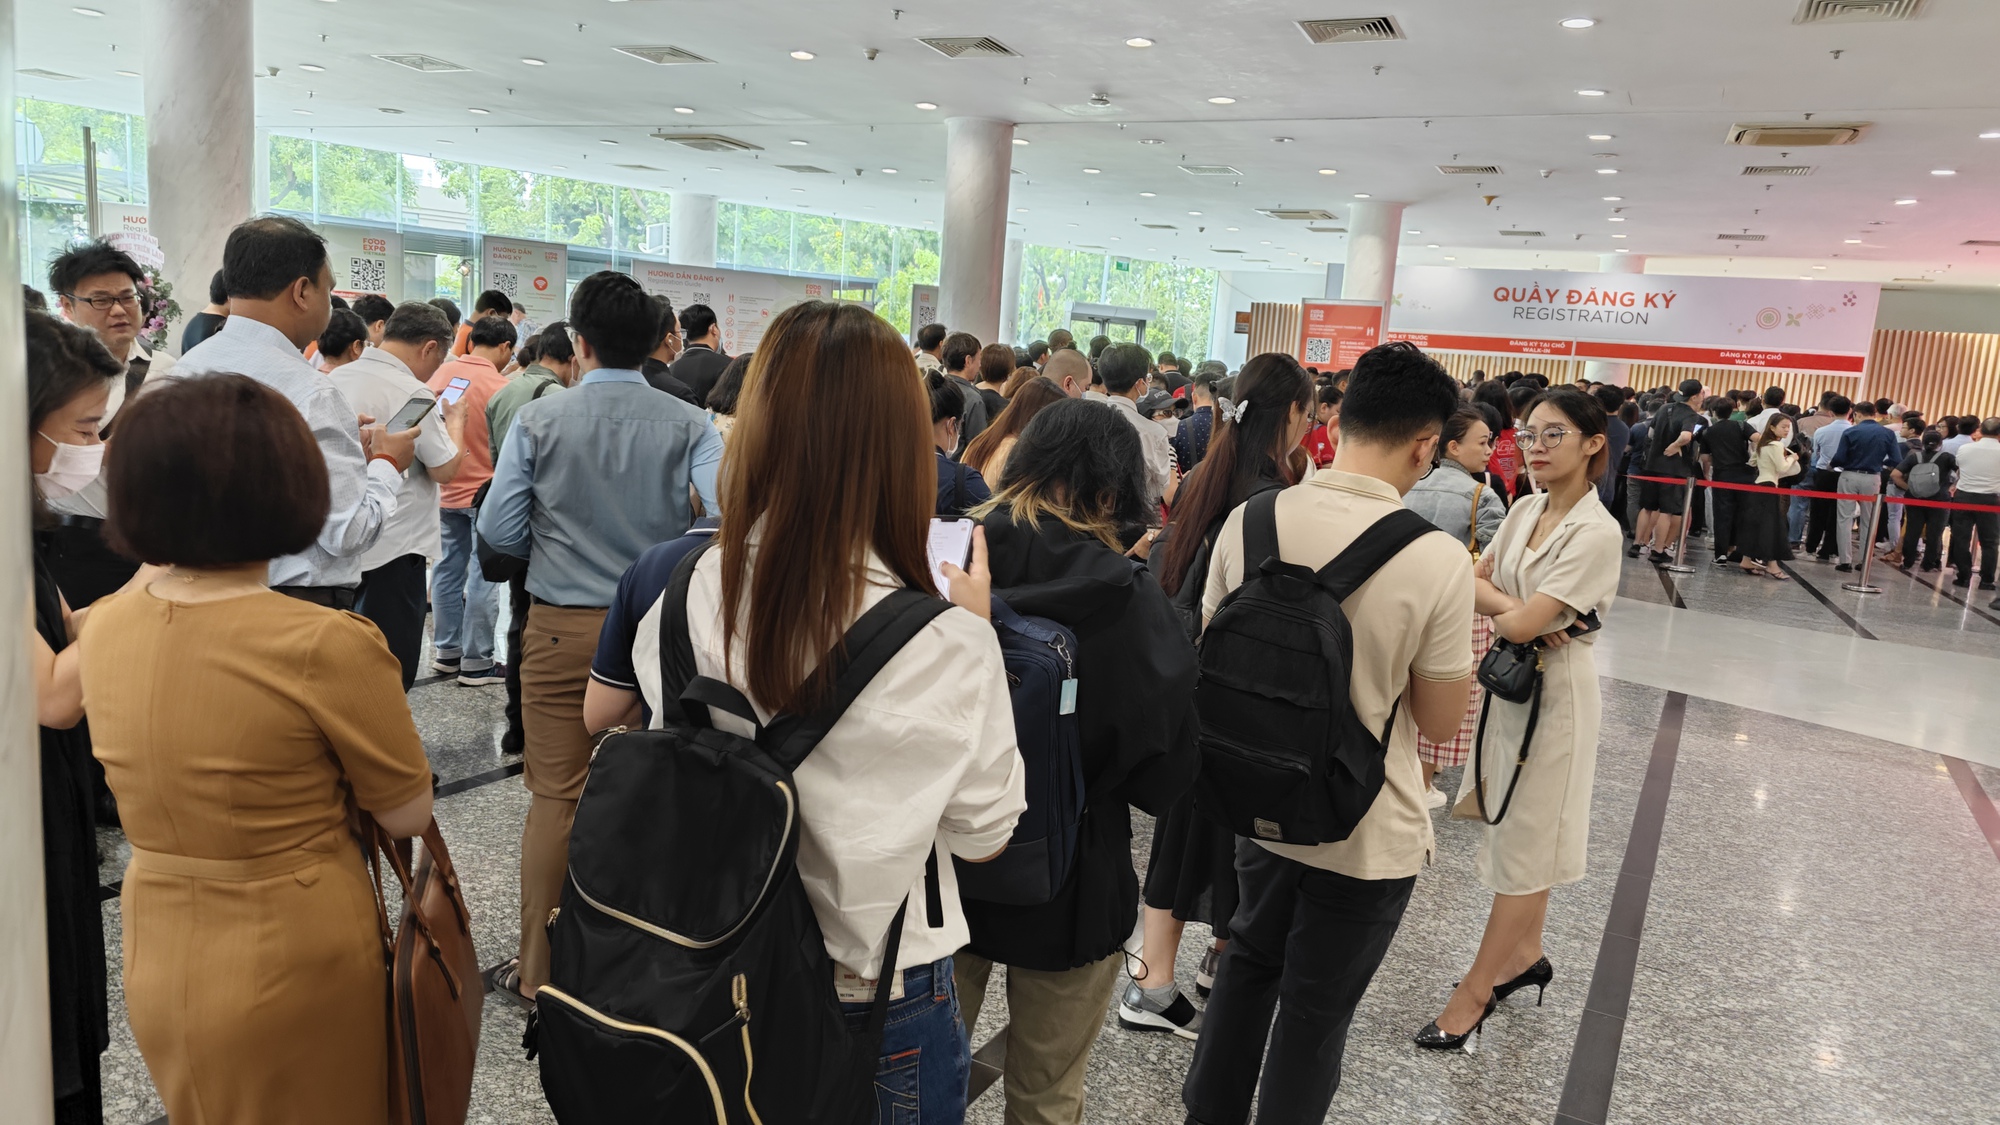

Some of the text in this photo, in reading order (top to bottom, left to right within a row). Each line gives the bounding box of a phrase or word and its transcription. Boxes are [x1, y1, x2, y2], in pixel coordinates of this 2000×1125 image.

[363, 238, 386, 246] FOOD
[1493, 281, 1677, 309] QUẦY ĐĂNG KÝ
[1513, 306, 1650, 325] REGISTRATION
